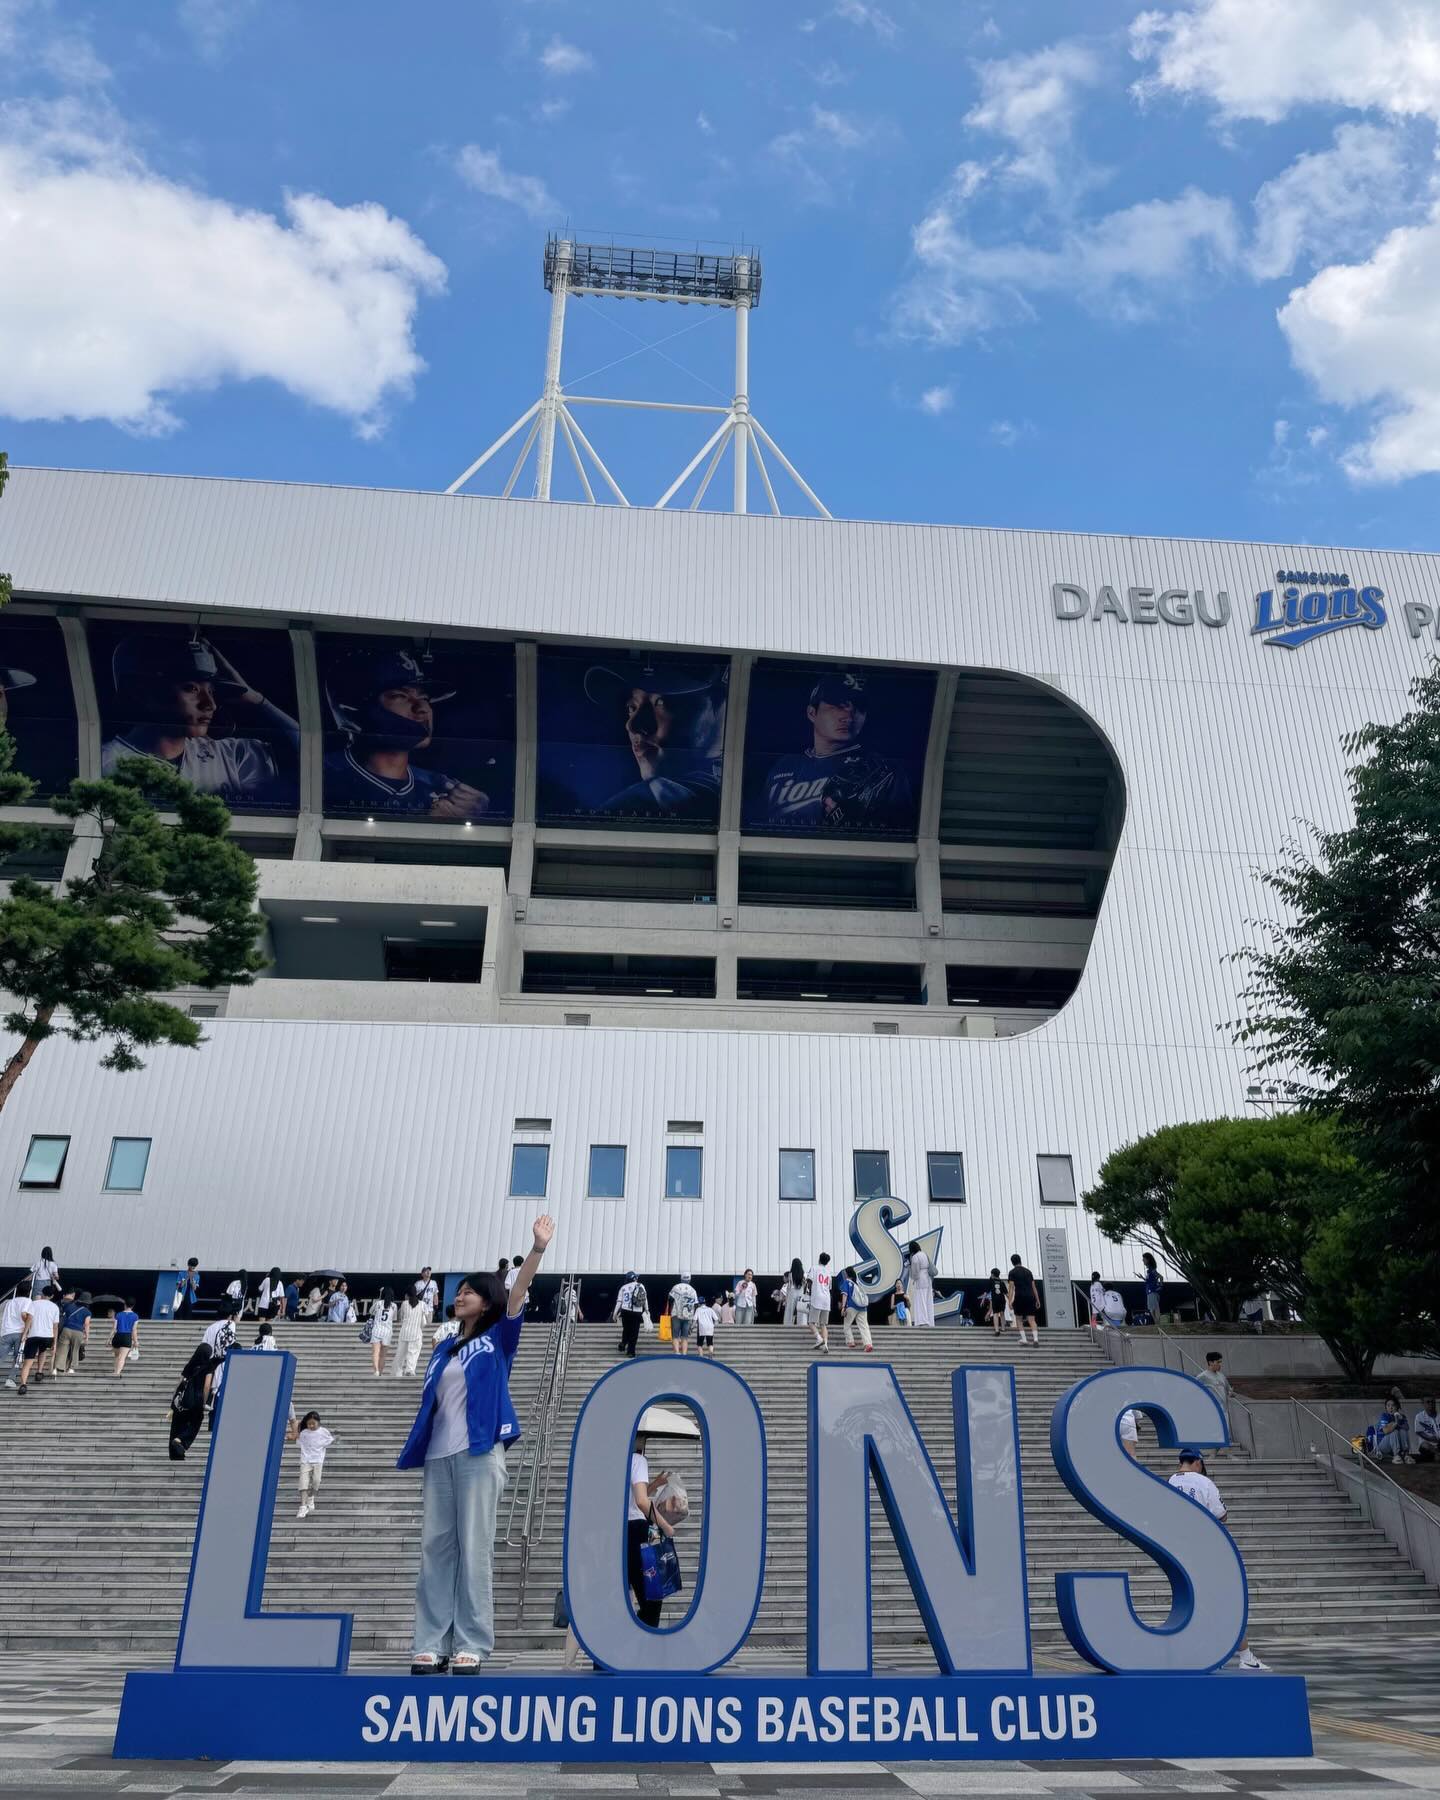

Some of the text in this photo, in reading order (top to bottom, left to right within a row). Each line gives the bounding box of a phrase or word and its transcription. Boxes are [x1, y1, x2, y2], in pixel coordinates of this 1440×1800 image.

[1276, 569, 1350, 586] SAMSUNG
[1053, 583, 1440, 641] DAEGU Lions P
[381, 1309, 390, 1322] 5
[174, 1350, 1248, 1676] LIONS
[361, 1694, 1098, 1744] SAMSUNG LIONS BASEBALL CLUB
